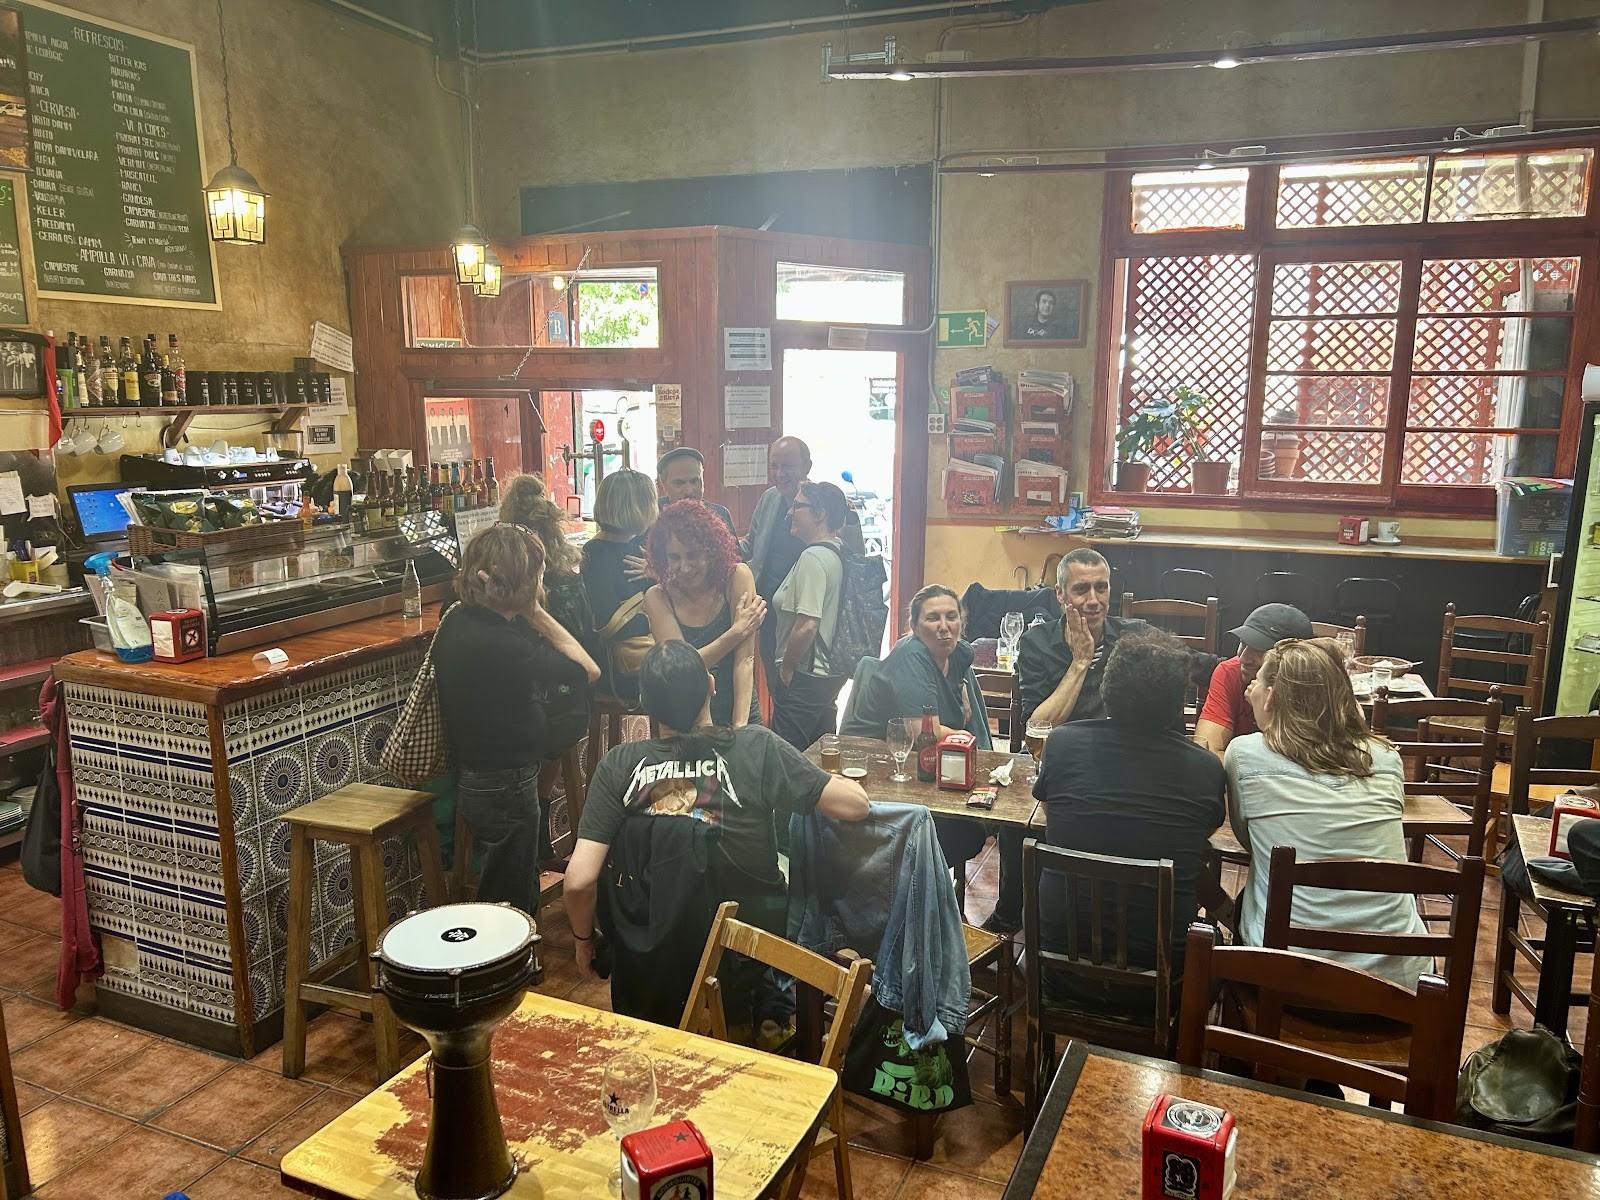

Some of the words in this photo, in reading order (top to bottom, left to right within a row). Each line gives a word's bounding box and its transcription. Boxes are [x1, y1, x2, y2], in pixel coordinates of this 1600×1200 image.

[74, 27, 125, 51] REFRESCOS
[109, 53, 133, 68] BITTER
[134, 60, 147, 71] KAS
[40, 100, 77, 119] CERVESA
[126, 118, 134, 131] VI
[138, 121, 143, 133] A
[145, 122, 166, 138] COPES
[120, 168, 158, 184] MOSCATELL
[36, 204, 66, 218] KELER
[80, 248, 116, 265] AMPOLLA
[119, 252, 129, 266] VI
[136, 254, 157, 269] CAVA
[554, 319, 562, 335] B
[623, 748, 742, 808] METALLICA
